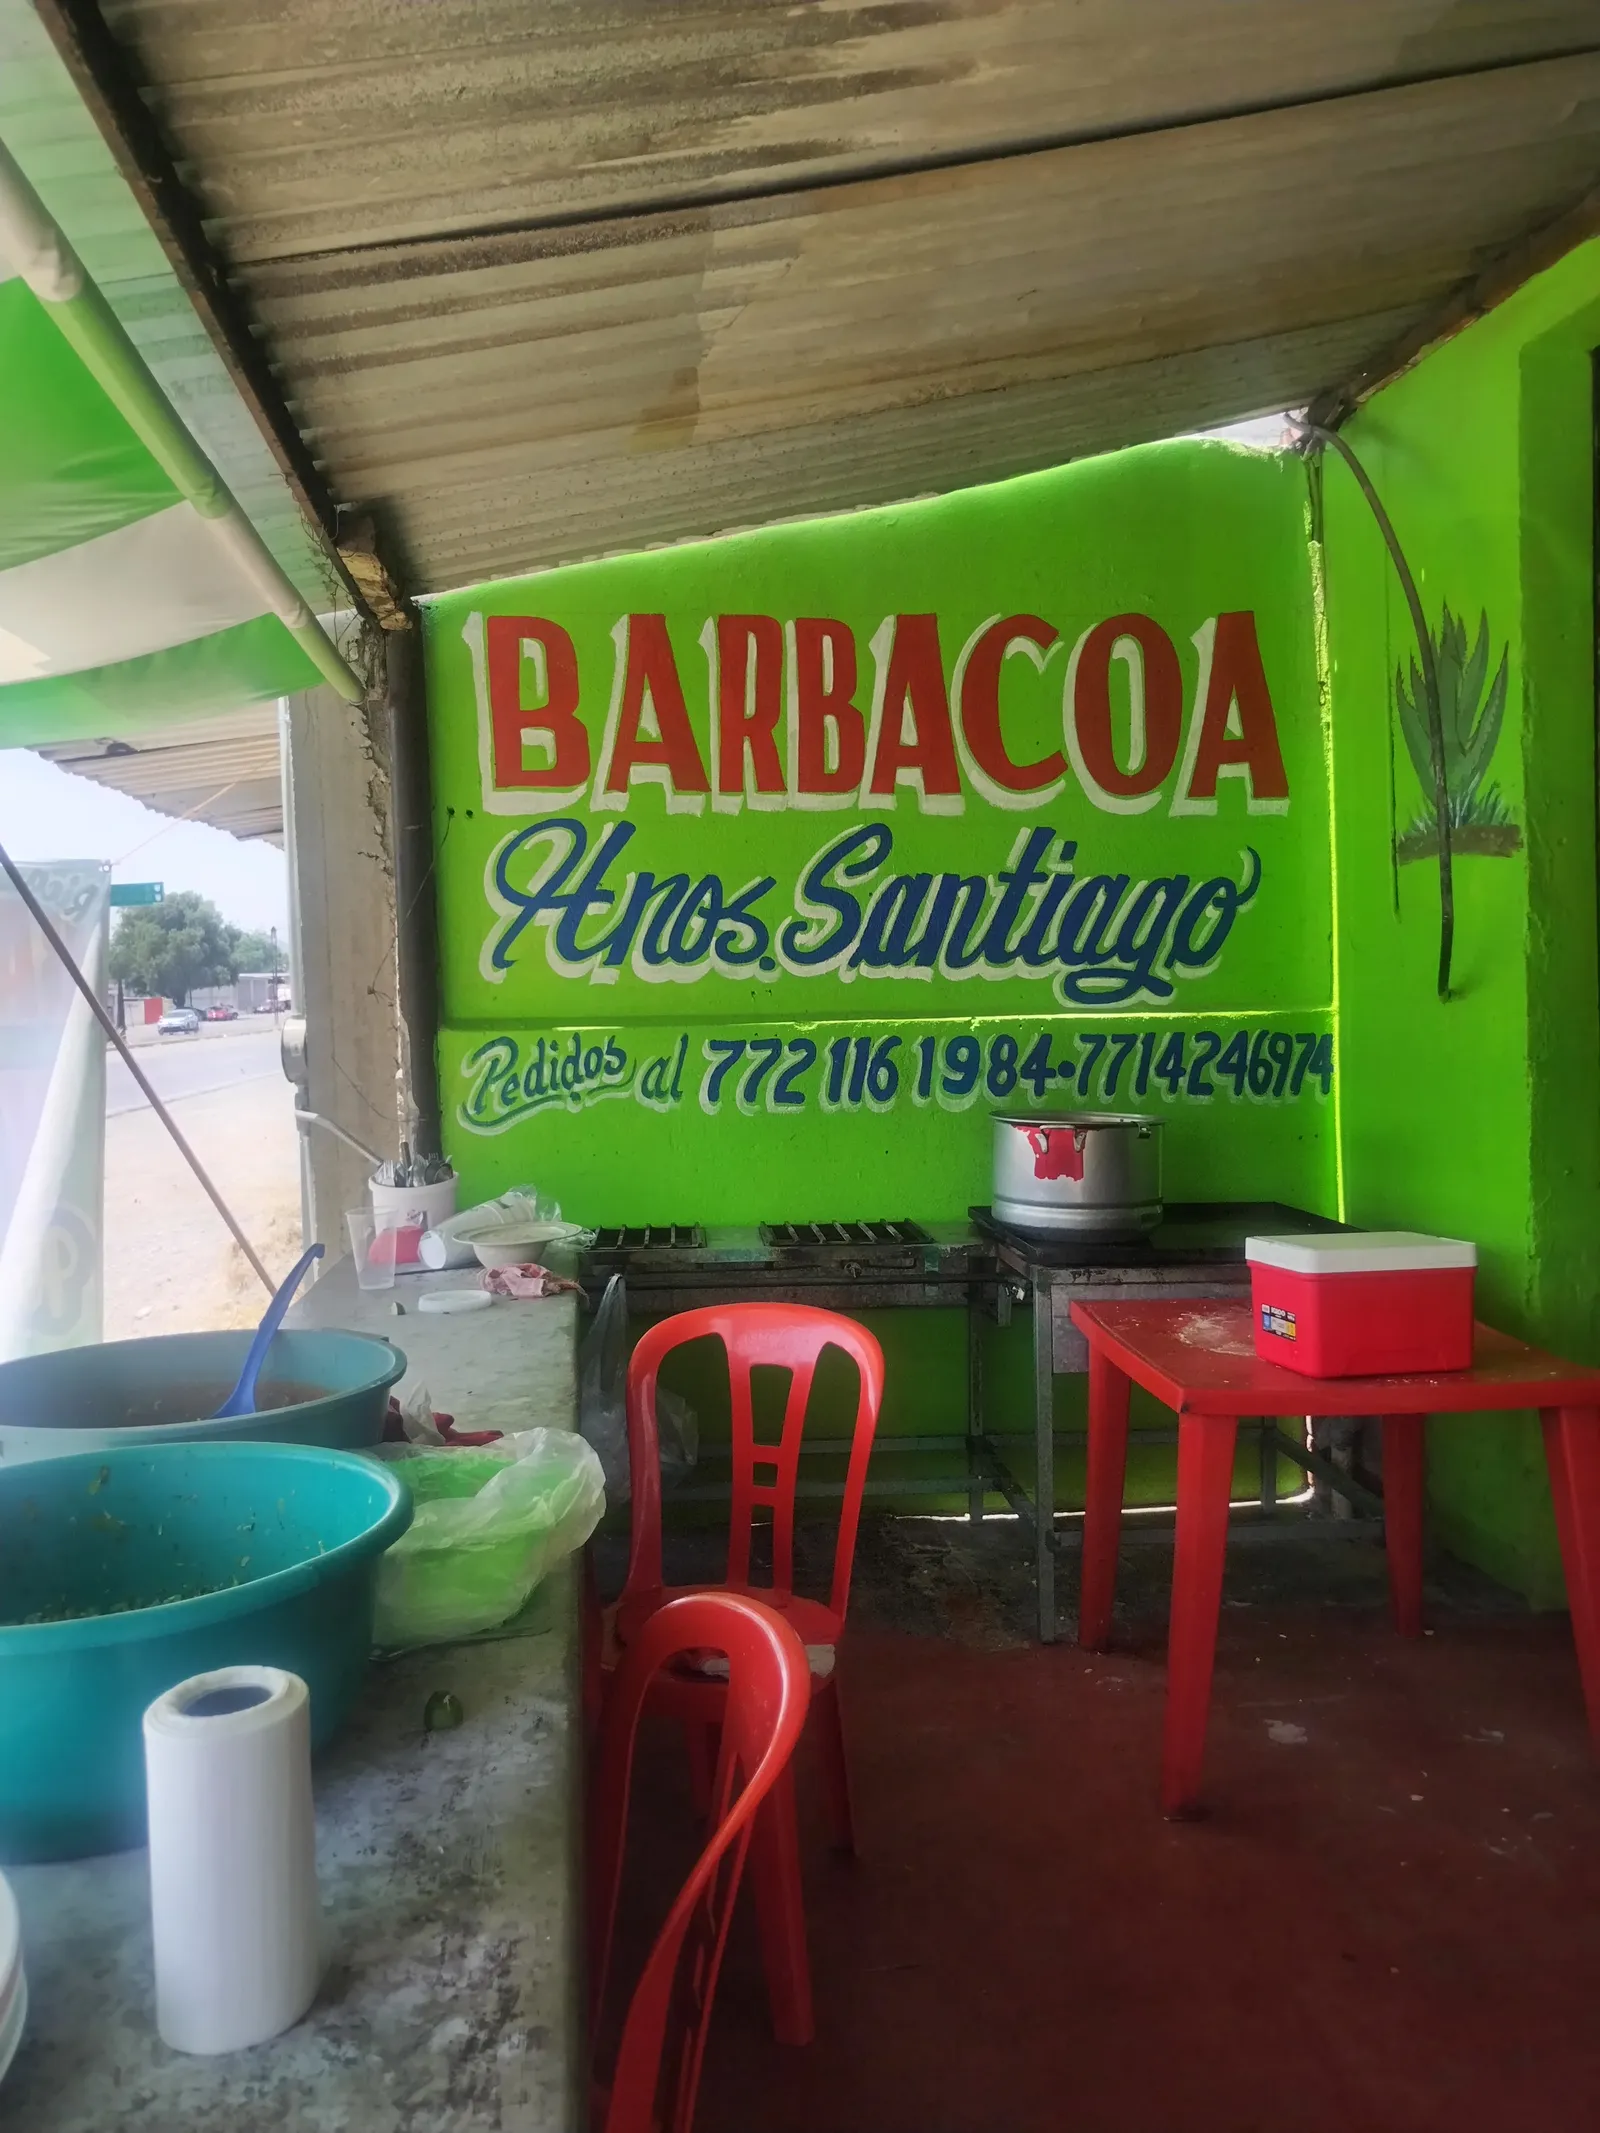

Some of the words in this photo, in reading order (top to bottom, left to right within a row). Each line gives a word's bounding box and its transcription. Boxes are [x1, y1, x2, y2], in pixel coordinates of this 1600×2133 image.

[485, 610, 1290, 801] BARBACOA
[780, 822, 1262, 1005] Santiago
[462, 1032, 636, 1127] Pedidos
[639, 1032, 689, 1102] al
[707, 1037, 818, 1106] 772
[827, 1034, 903, 1102] 116
